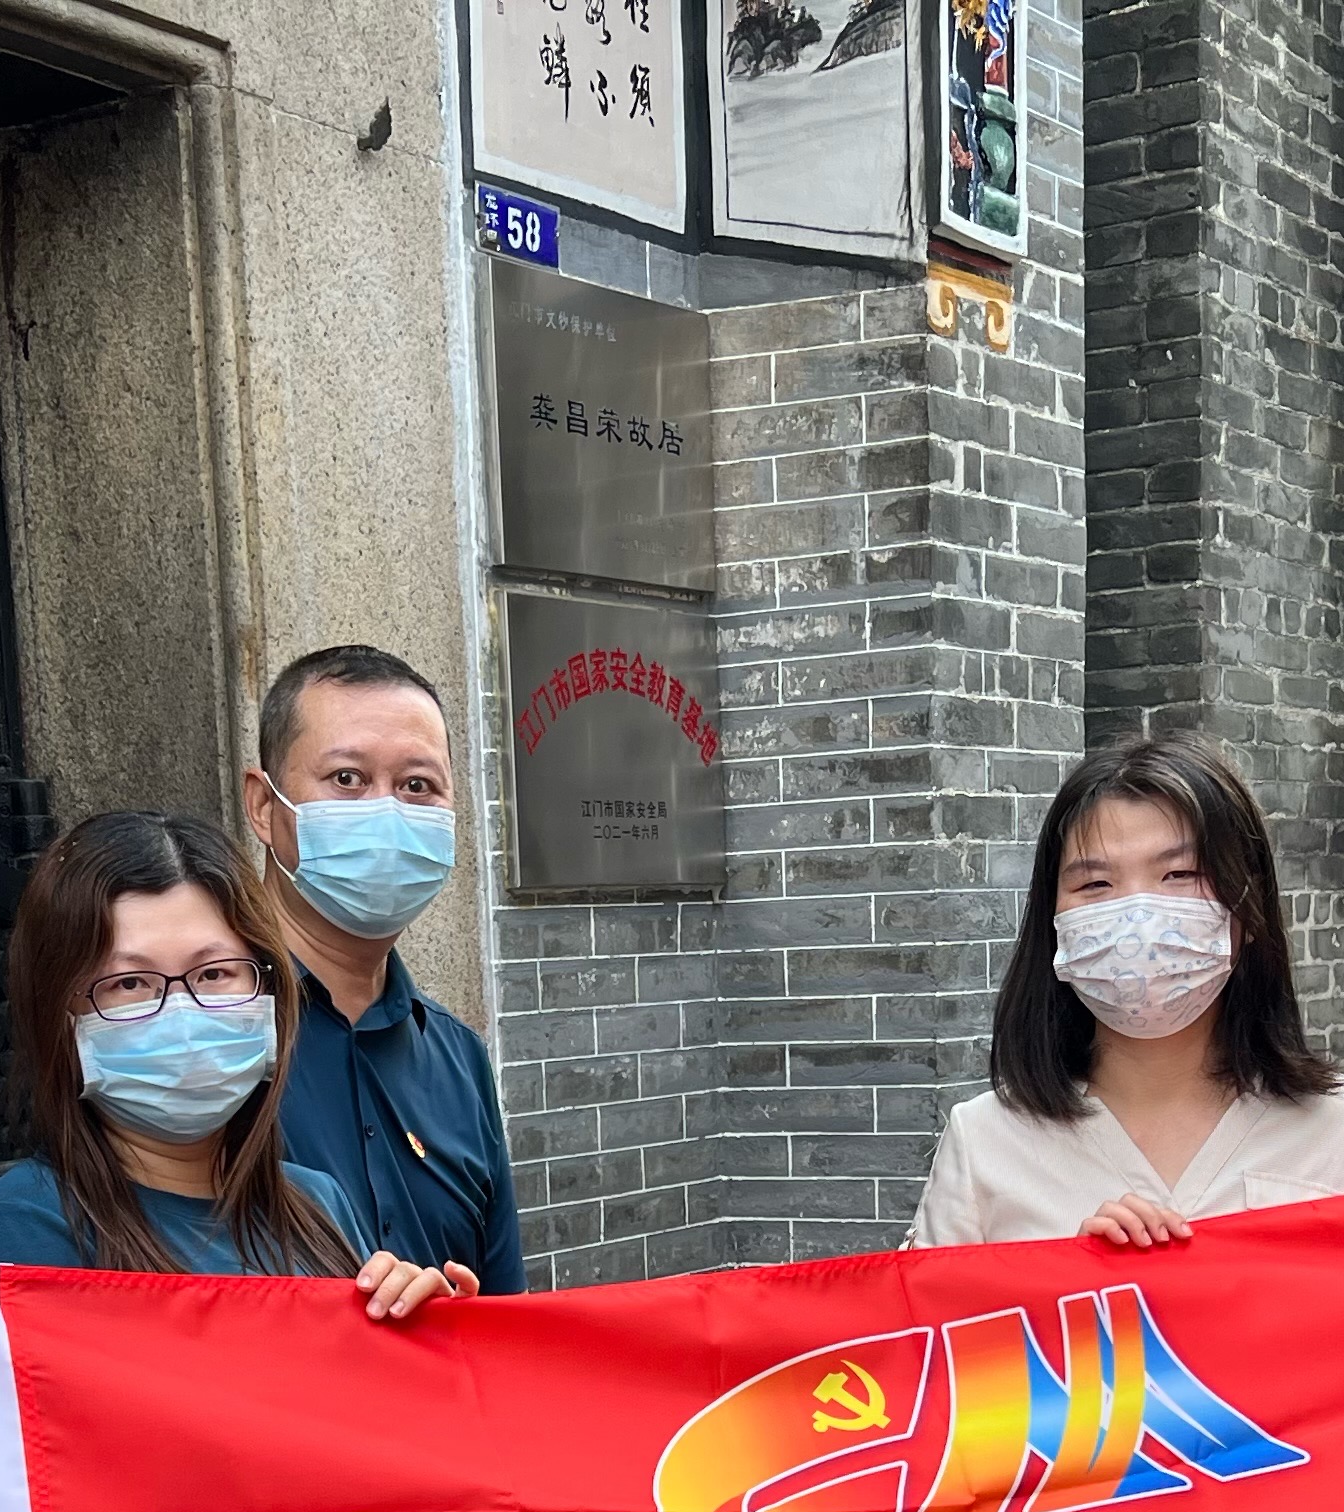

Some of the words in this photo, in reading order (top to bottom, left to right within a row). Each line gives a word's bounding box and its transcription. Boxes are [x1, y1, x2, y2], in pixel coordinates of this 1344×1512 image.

[507, 206, 541, 252] 58
[530, 393, 684, 456] 龚昌荣故居
[515, 647, 720, 767] 江门市国家安全教育基地
[581, 800, 667, 818] 江门市国家安全局
